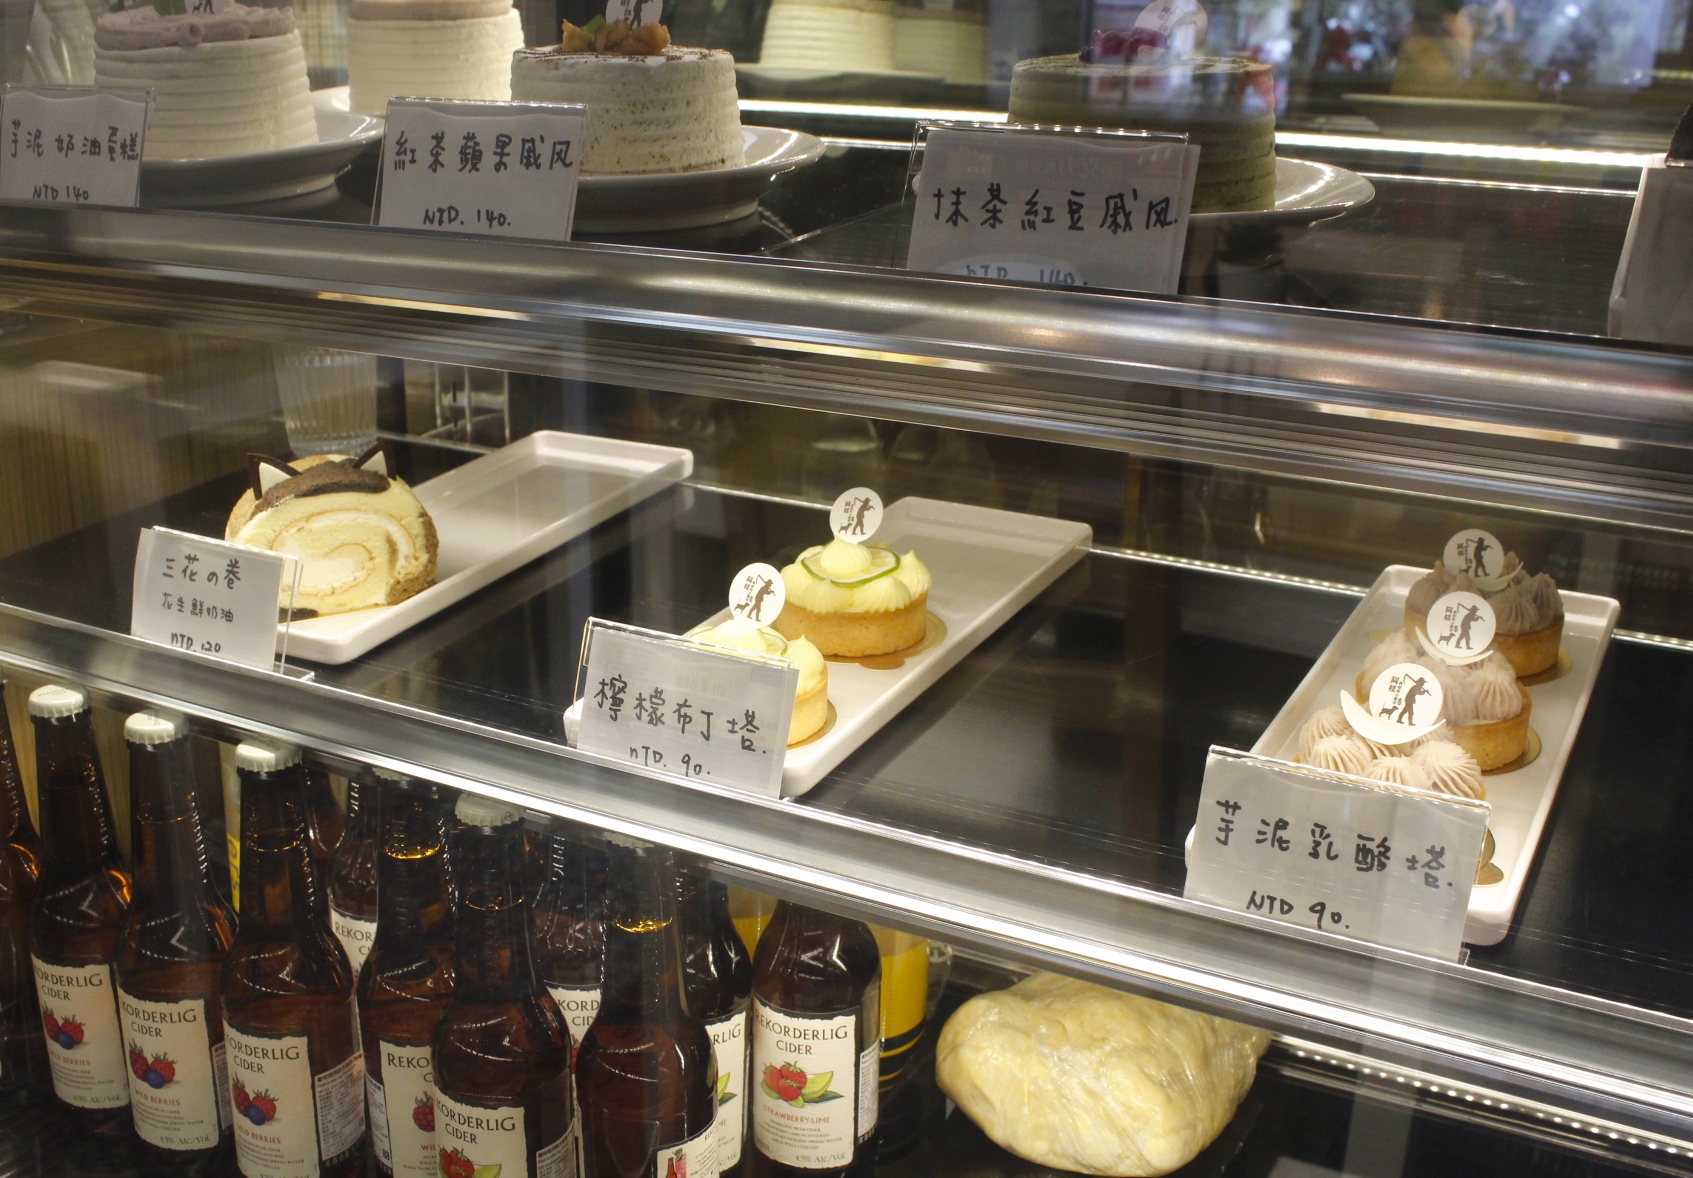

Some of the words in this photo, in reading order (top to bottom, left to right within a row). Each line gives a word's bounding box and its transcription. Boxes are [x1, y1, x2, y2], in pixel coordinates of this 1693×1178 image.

[32, 184, 59, 200] NTD
[66, 185, 89, 201] 140
[1246, 890, 1294, 916] NTD
[41, 984, 70, 1001] CIDER
[131, 1021, 163, 1038] CIDER
[755, 1008, 848, 1041] REKORDERLIG
[776, 1039, 813, 1056] CIDER
[233, 1055, 264, 1075] CIDER
[387, 1052, 430, 1069] REKO
[150, 1095, 181, 1106] BERRIES
[763, 1104, 831, 1124] STRAWBERRY-LIME
[250, 1131, 282, 1144] BERRIES
[445, 1123, 478, 1145] CIDER
